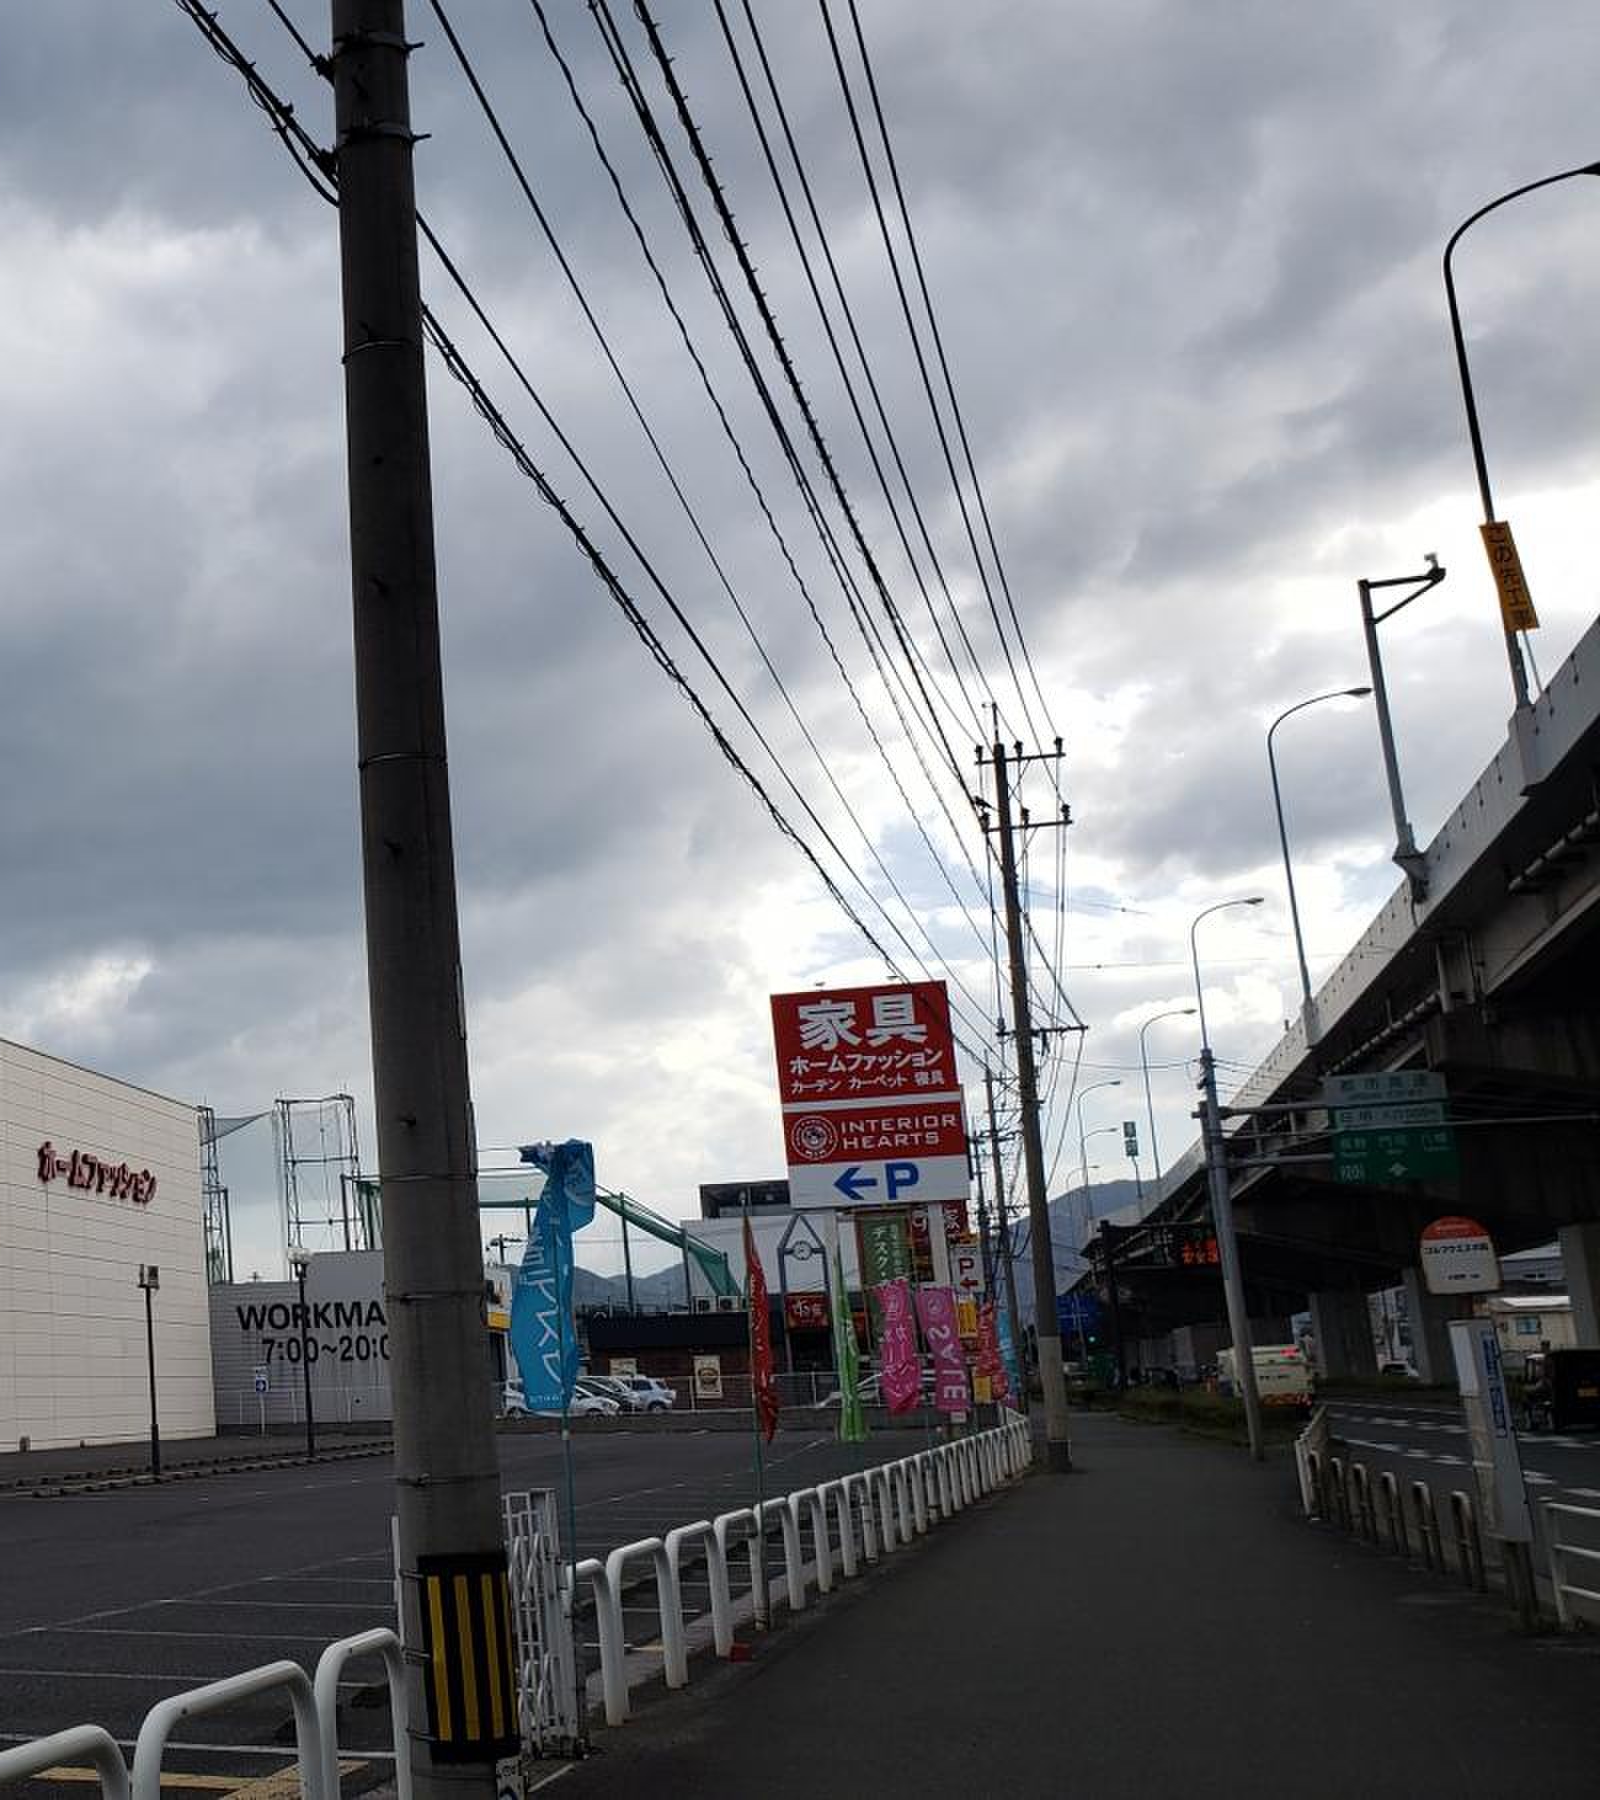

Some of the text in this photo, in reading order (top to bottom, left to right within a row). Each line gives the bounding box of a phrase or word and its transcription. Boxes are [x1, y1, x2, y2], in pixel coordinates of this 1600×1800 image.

[798, 993, 928, 1051] 家具
[790, 1048, 943, 1076] ホームファッション
[850, 1073, 908, 1090] カーペット
[841, 1114, 958, 1135] INTERIOR
[843, 1131, 939, 1150] HEARTS
[885, 1161, 919, 1200] P
[236, 1300, 386, 1331] WORKMA
[261, 1333, 390, 1365] 7:00~20:0
